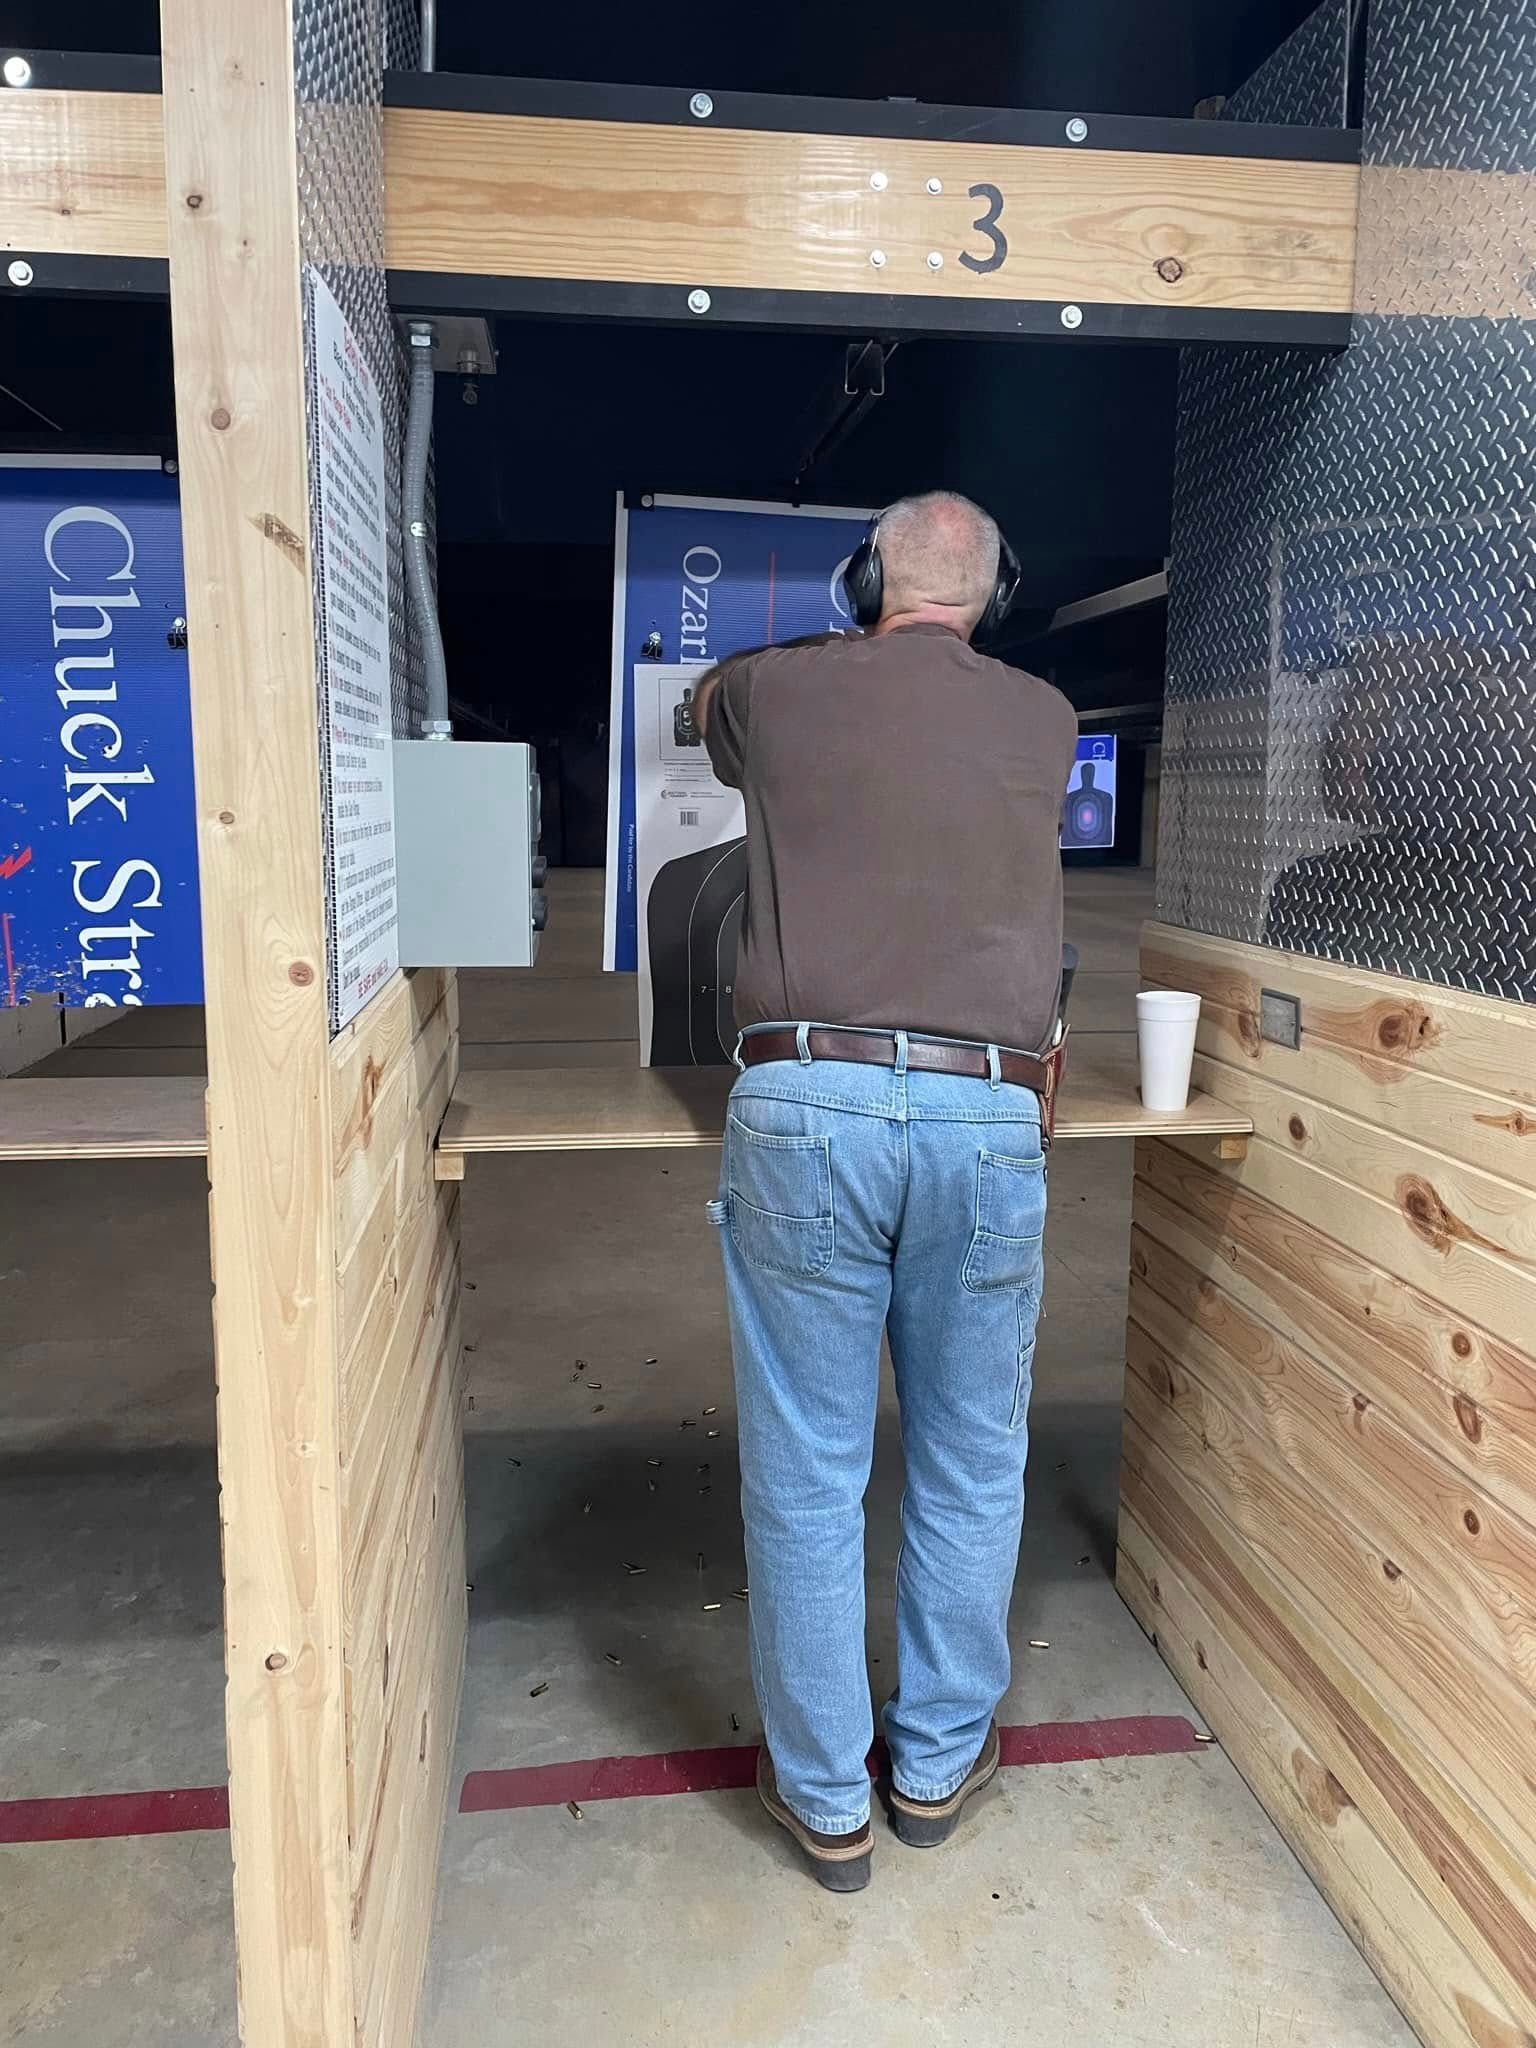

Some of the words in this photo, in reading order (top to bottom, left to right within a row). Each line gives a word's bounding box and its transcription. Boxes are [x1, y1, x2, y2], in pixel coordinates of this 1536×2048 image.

[958, 183, 1008, 274] 3
[43, 505, 155, 825] Chuck
[700, 985, 707, 993] 7
[725, 985, 732, 993] 8
